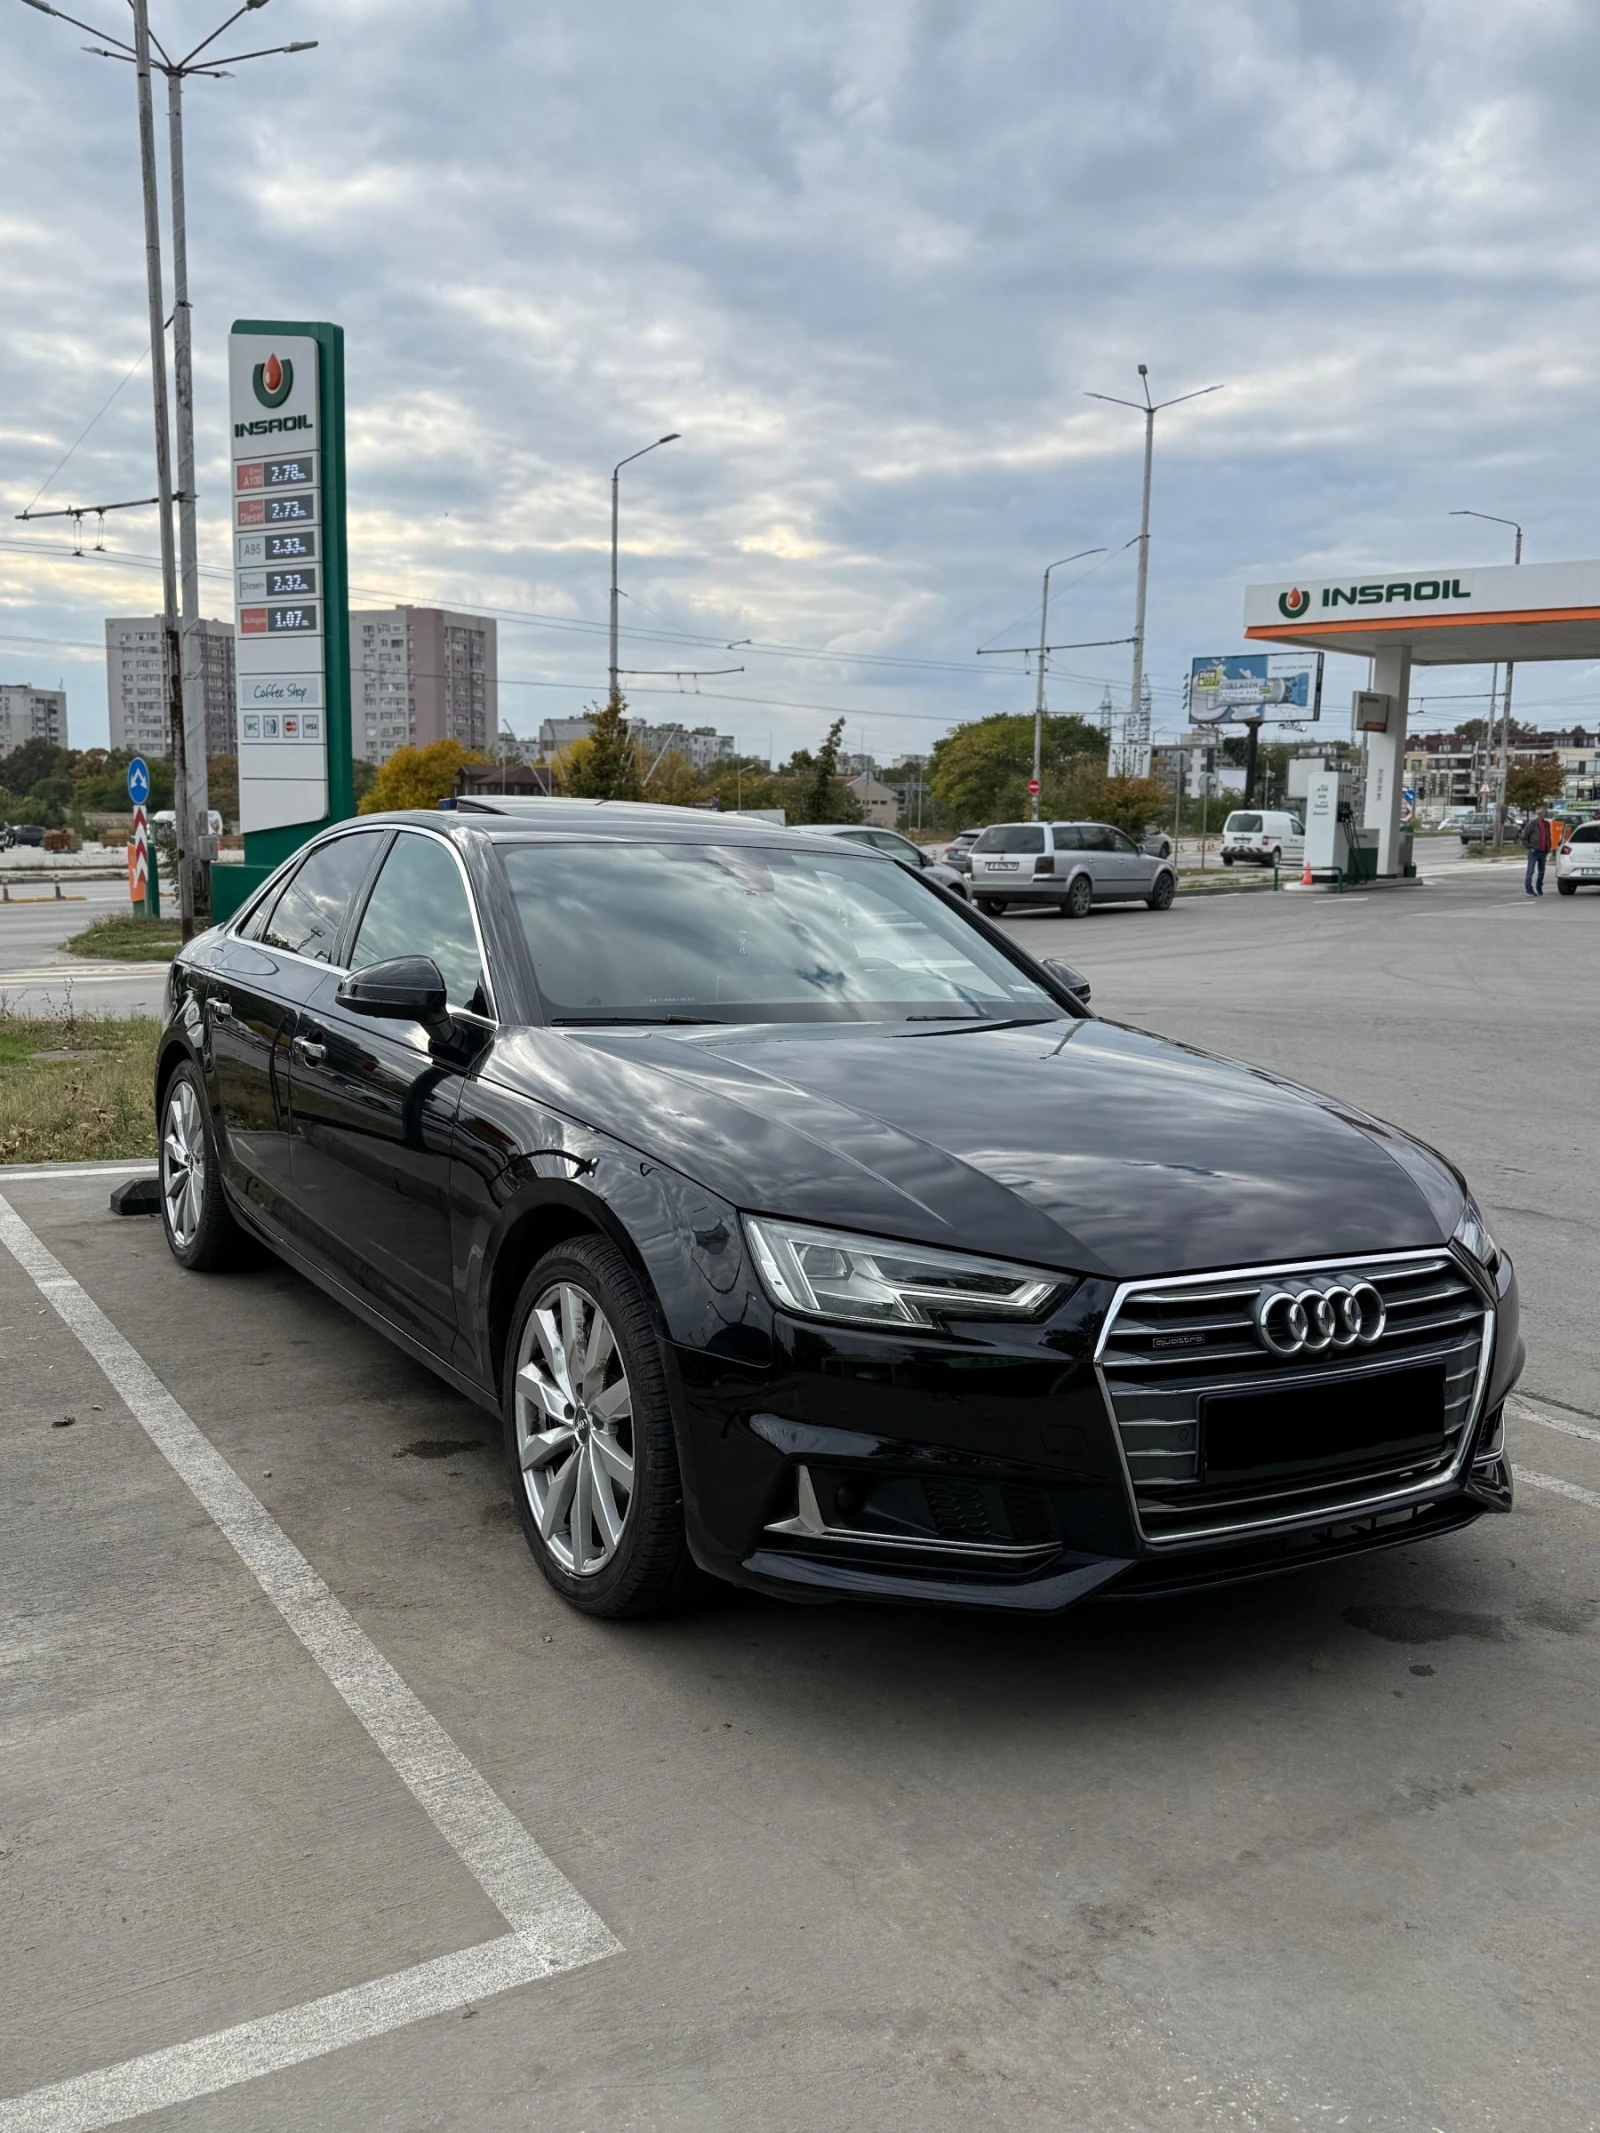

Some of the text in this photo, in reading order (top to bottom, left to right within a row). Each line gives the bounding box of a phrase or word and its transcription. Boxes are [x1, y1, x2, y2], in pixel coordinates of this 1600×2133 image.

[234, 414, 313, 438] INSAOIL
[243, 475, 262, 487] A100
[240, 511, 264, 523] Diesel
[272, 501, 299, 518] 2.73
[244, 538, 300, 556] A95 2.33
[274, 574, 301, 591] 2.32
[1322, 579, 1471, 608] INSAOIL
[275, 610, 302, 627] 1.07
[254, 682, 307, 702] Coffee Shop
[247, 722, 258, 731] WC
[1155, 1336, 1203, 1347] quattro
